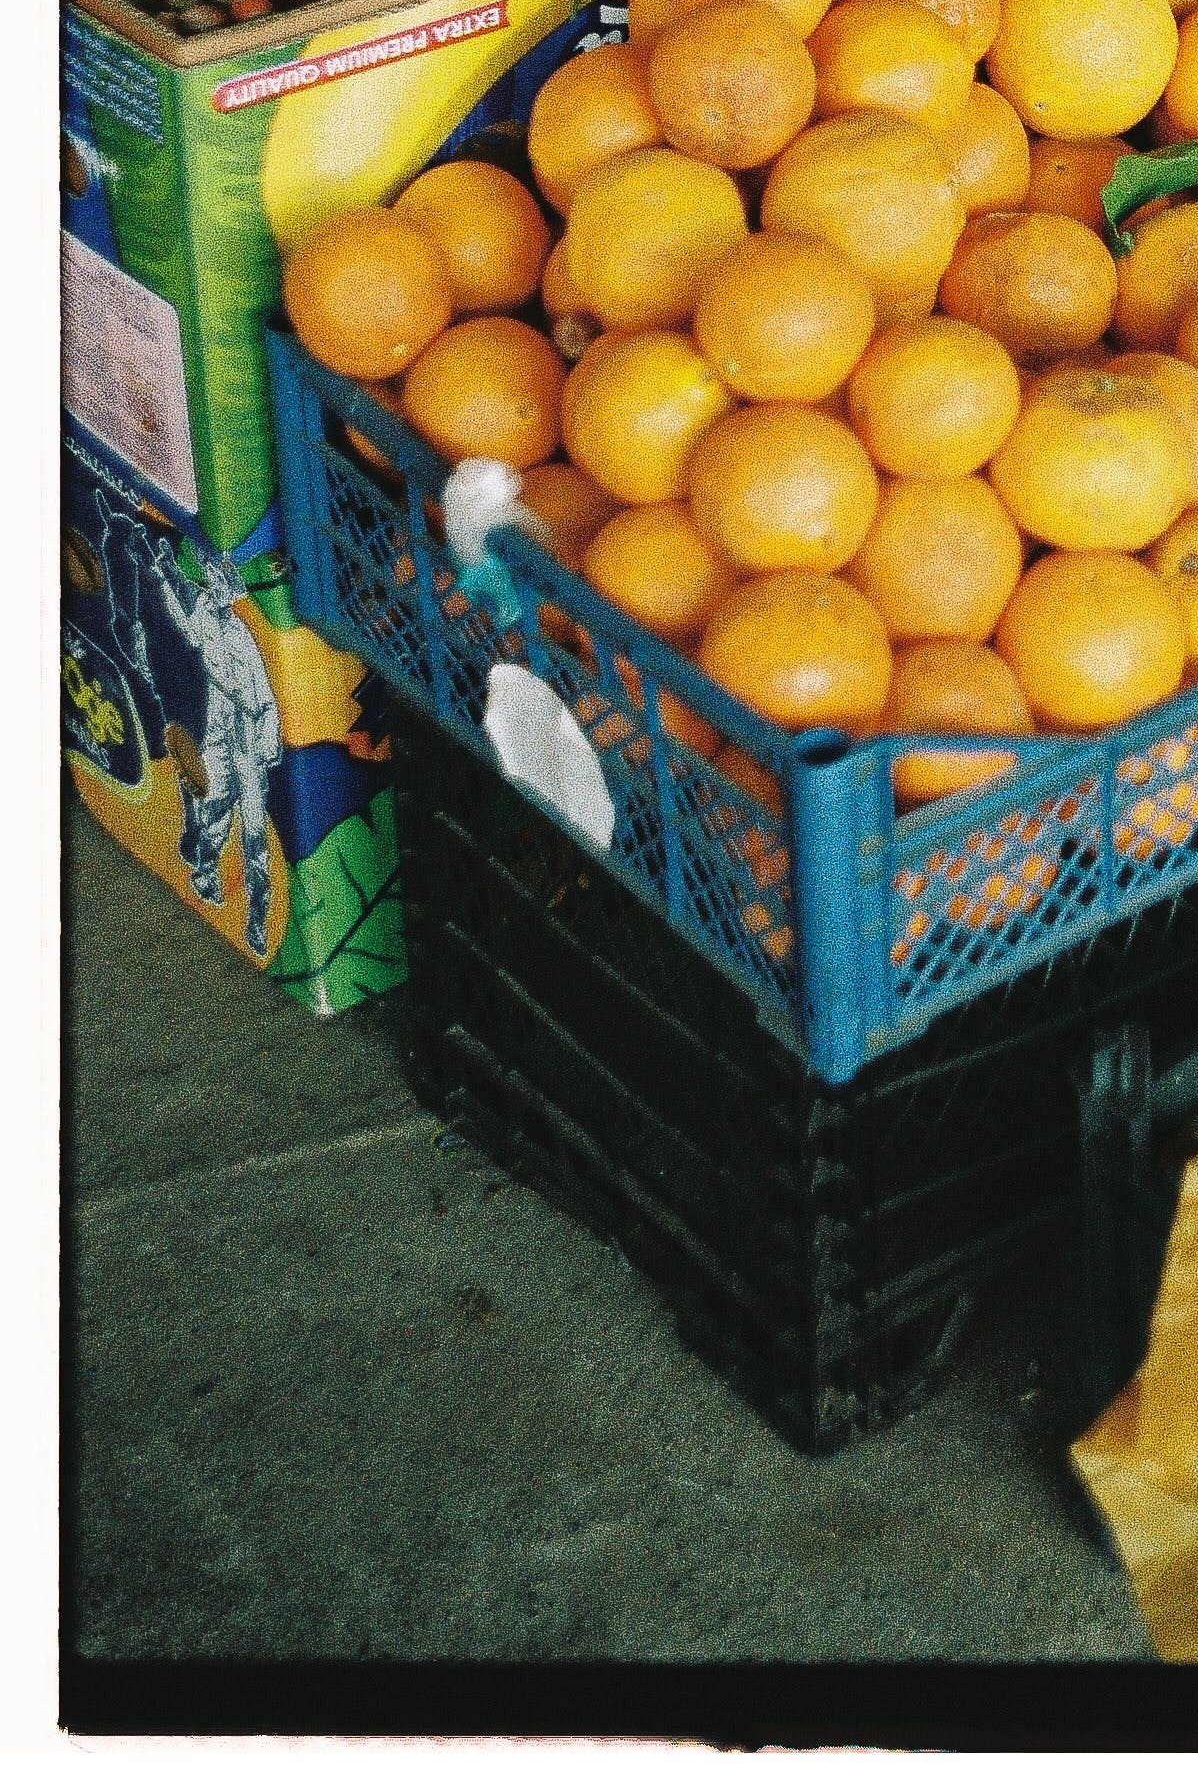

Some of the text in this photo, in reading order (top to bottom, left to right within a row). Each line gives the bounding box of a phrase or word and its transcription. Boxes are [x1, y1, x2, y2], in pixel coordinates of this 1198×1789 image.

[225, 7, 501, 107] EXTRA PREMIUM QUALITY
